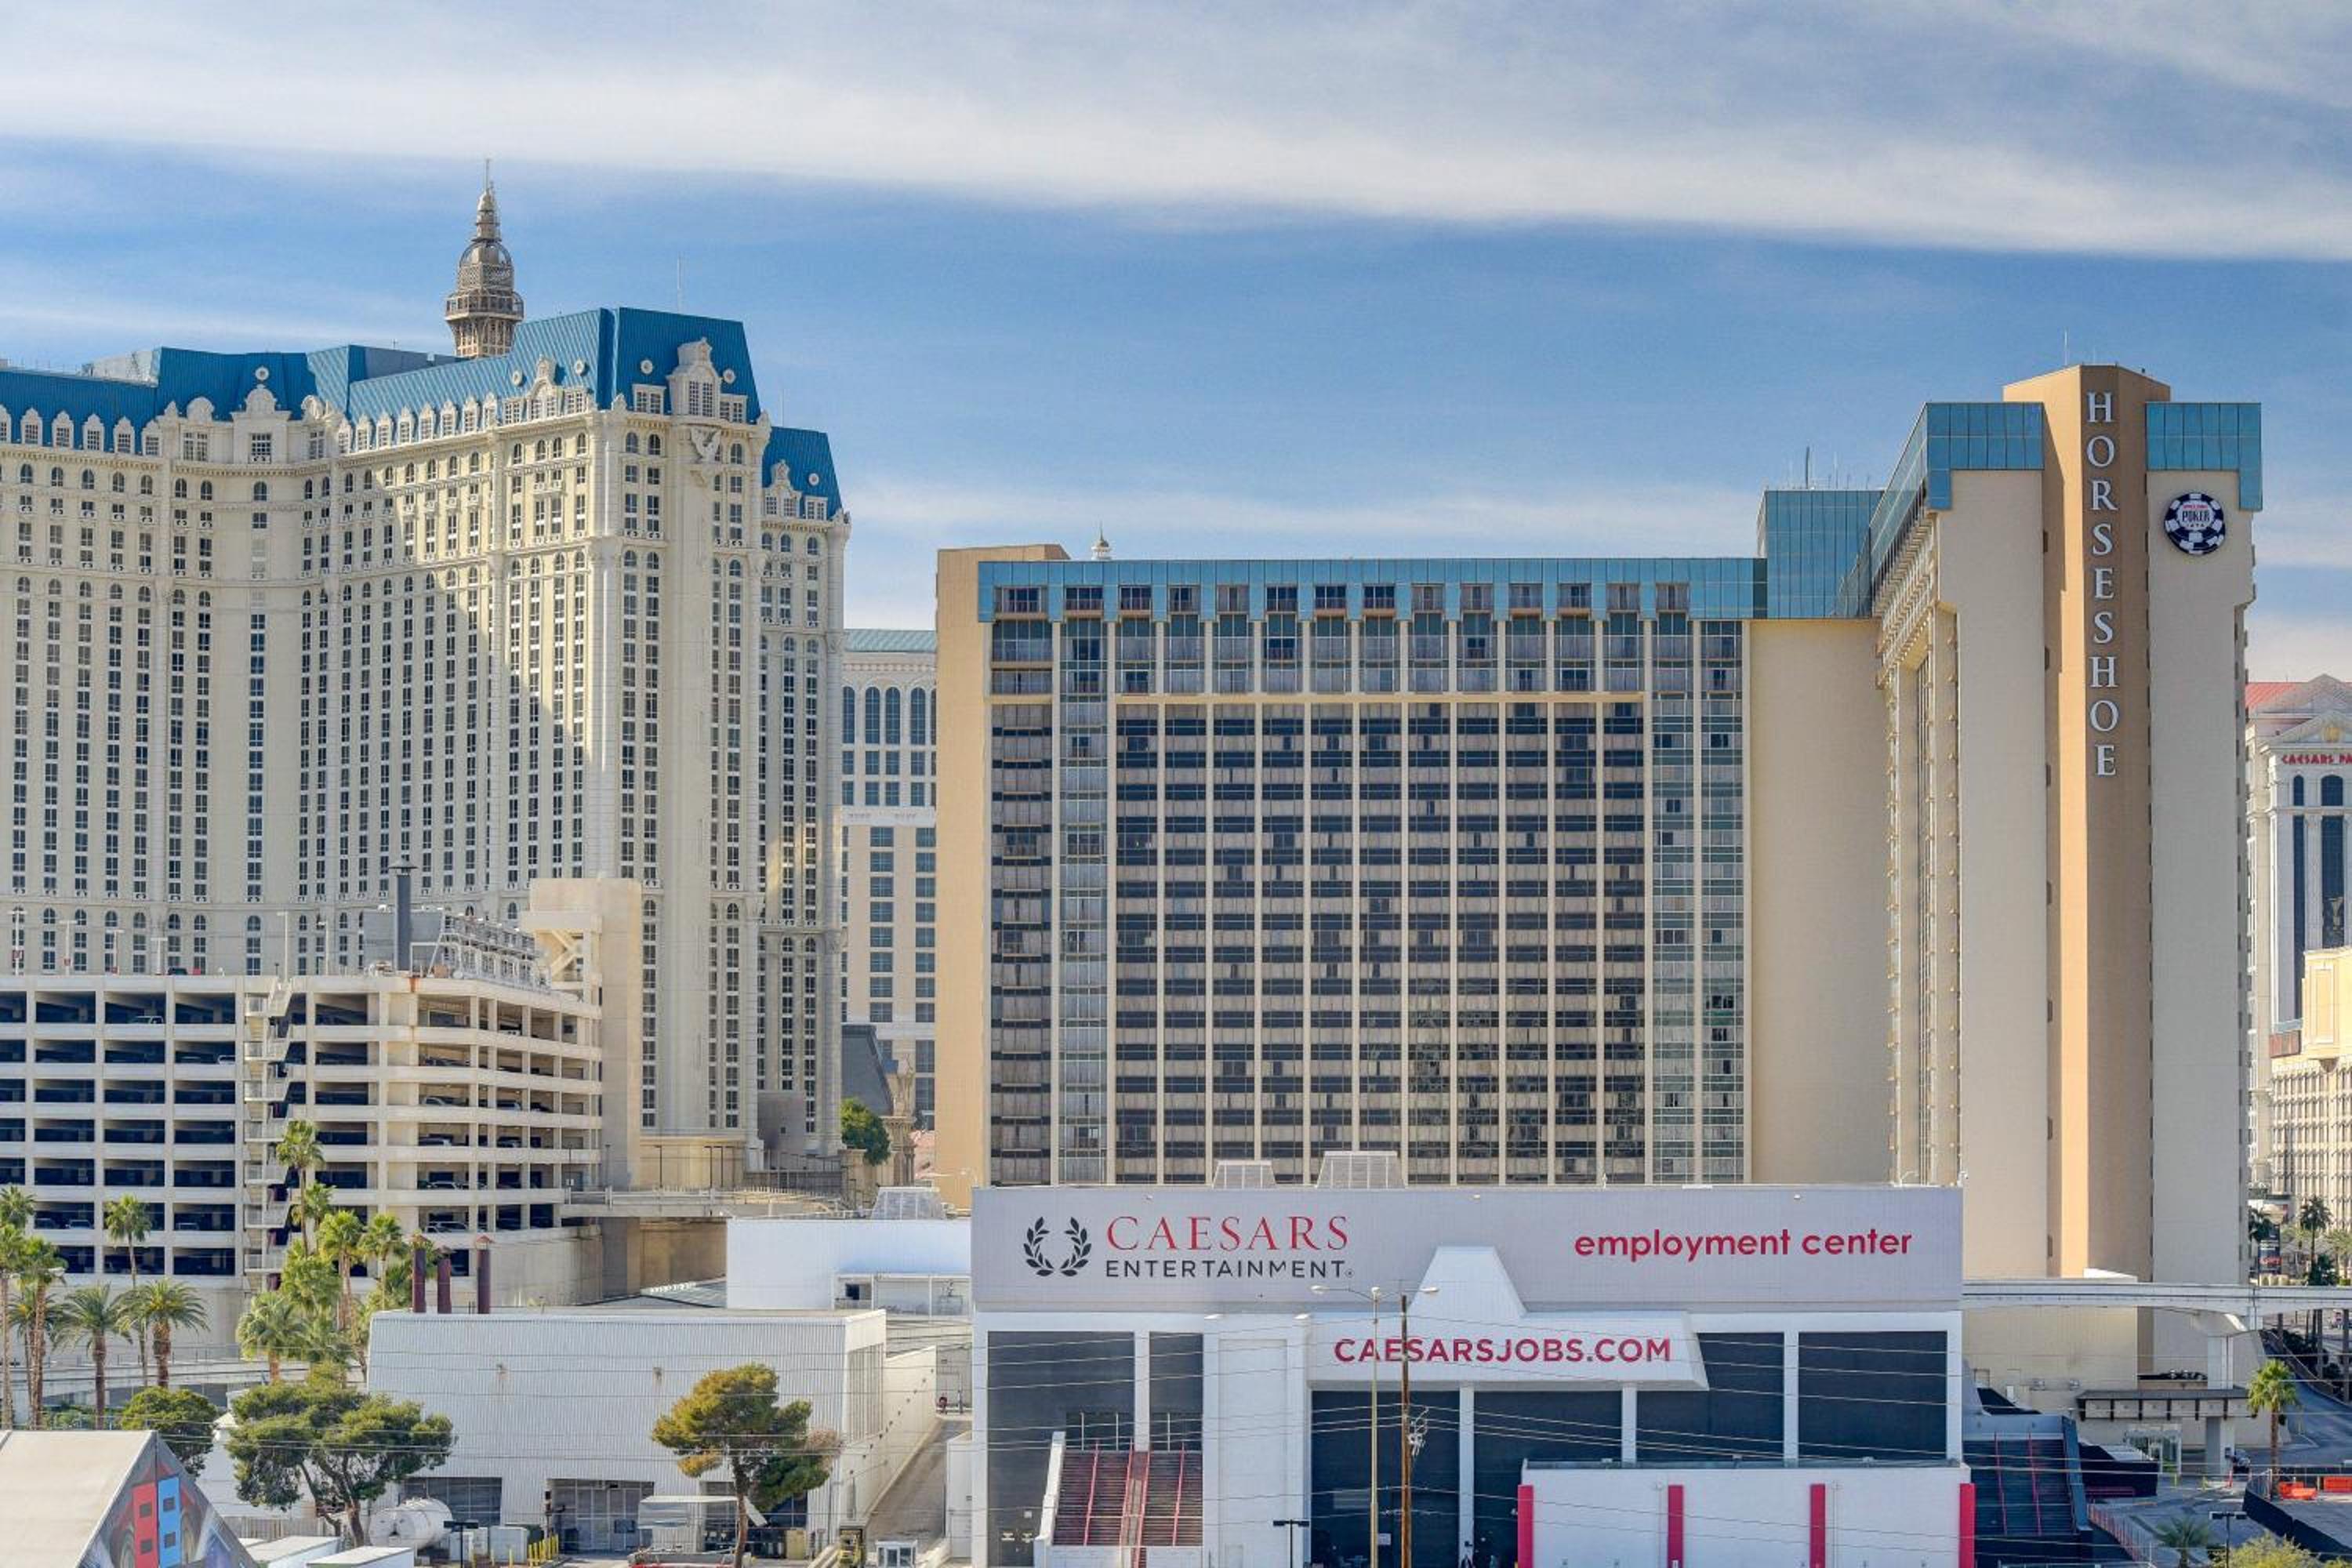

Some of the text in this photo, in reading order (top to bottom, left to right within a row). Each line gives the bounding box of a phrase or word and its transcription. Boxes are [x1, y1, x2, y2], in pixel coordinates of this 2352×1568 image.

[2086, 392, 2119, 776] HORSESHOE
[2282, 754, 2334, 765] CAESARS
[1106, 1215, 1348, 1251] CAESARS
[1574, 1229, 1912, 1262] employment center
[1334, 1338, 1671, 1363] CAESARSJOBS.COM
